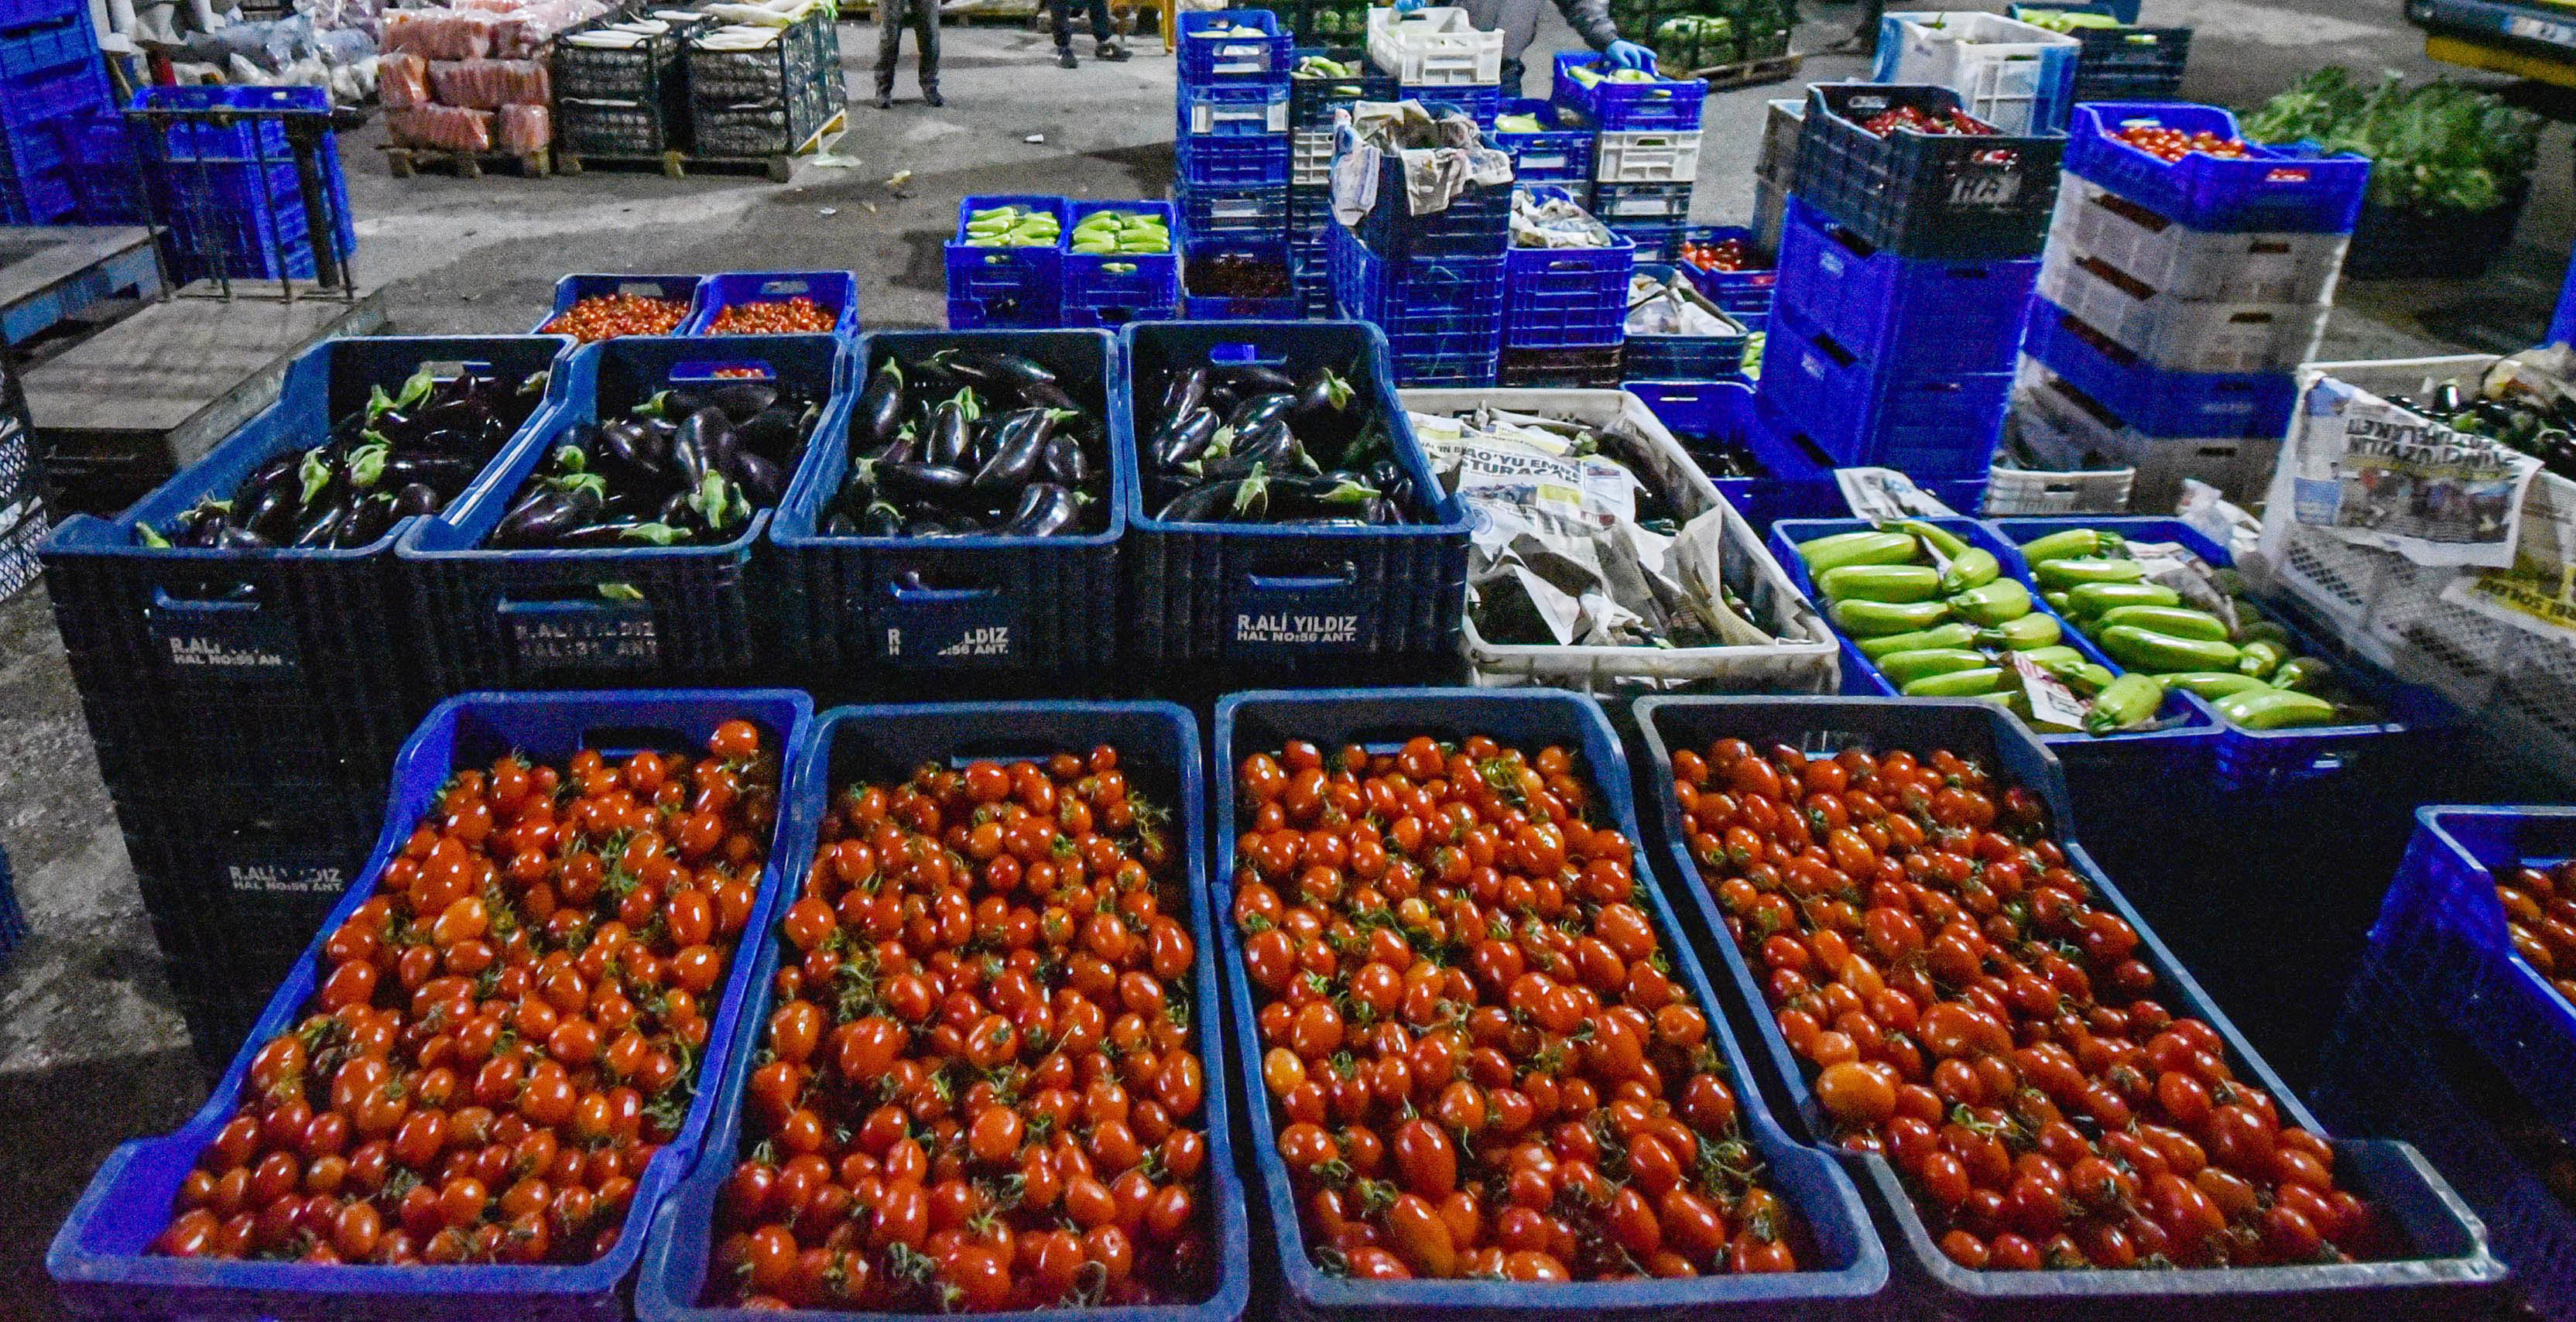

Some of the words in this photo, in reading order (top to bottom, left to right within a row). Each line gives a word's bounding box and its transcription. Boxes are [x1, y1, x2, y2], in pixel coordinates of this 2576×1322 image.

[1293, 616, 1358, 632] YILDIZ
[964, 627, 1009, 644] LDIZ
[1237, 631, 1267, 641] HAL
[1321, 632, 1356, 642] ANT.
[974, 644, 1009, 655] ANT.
